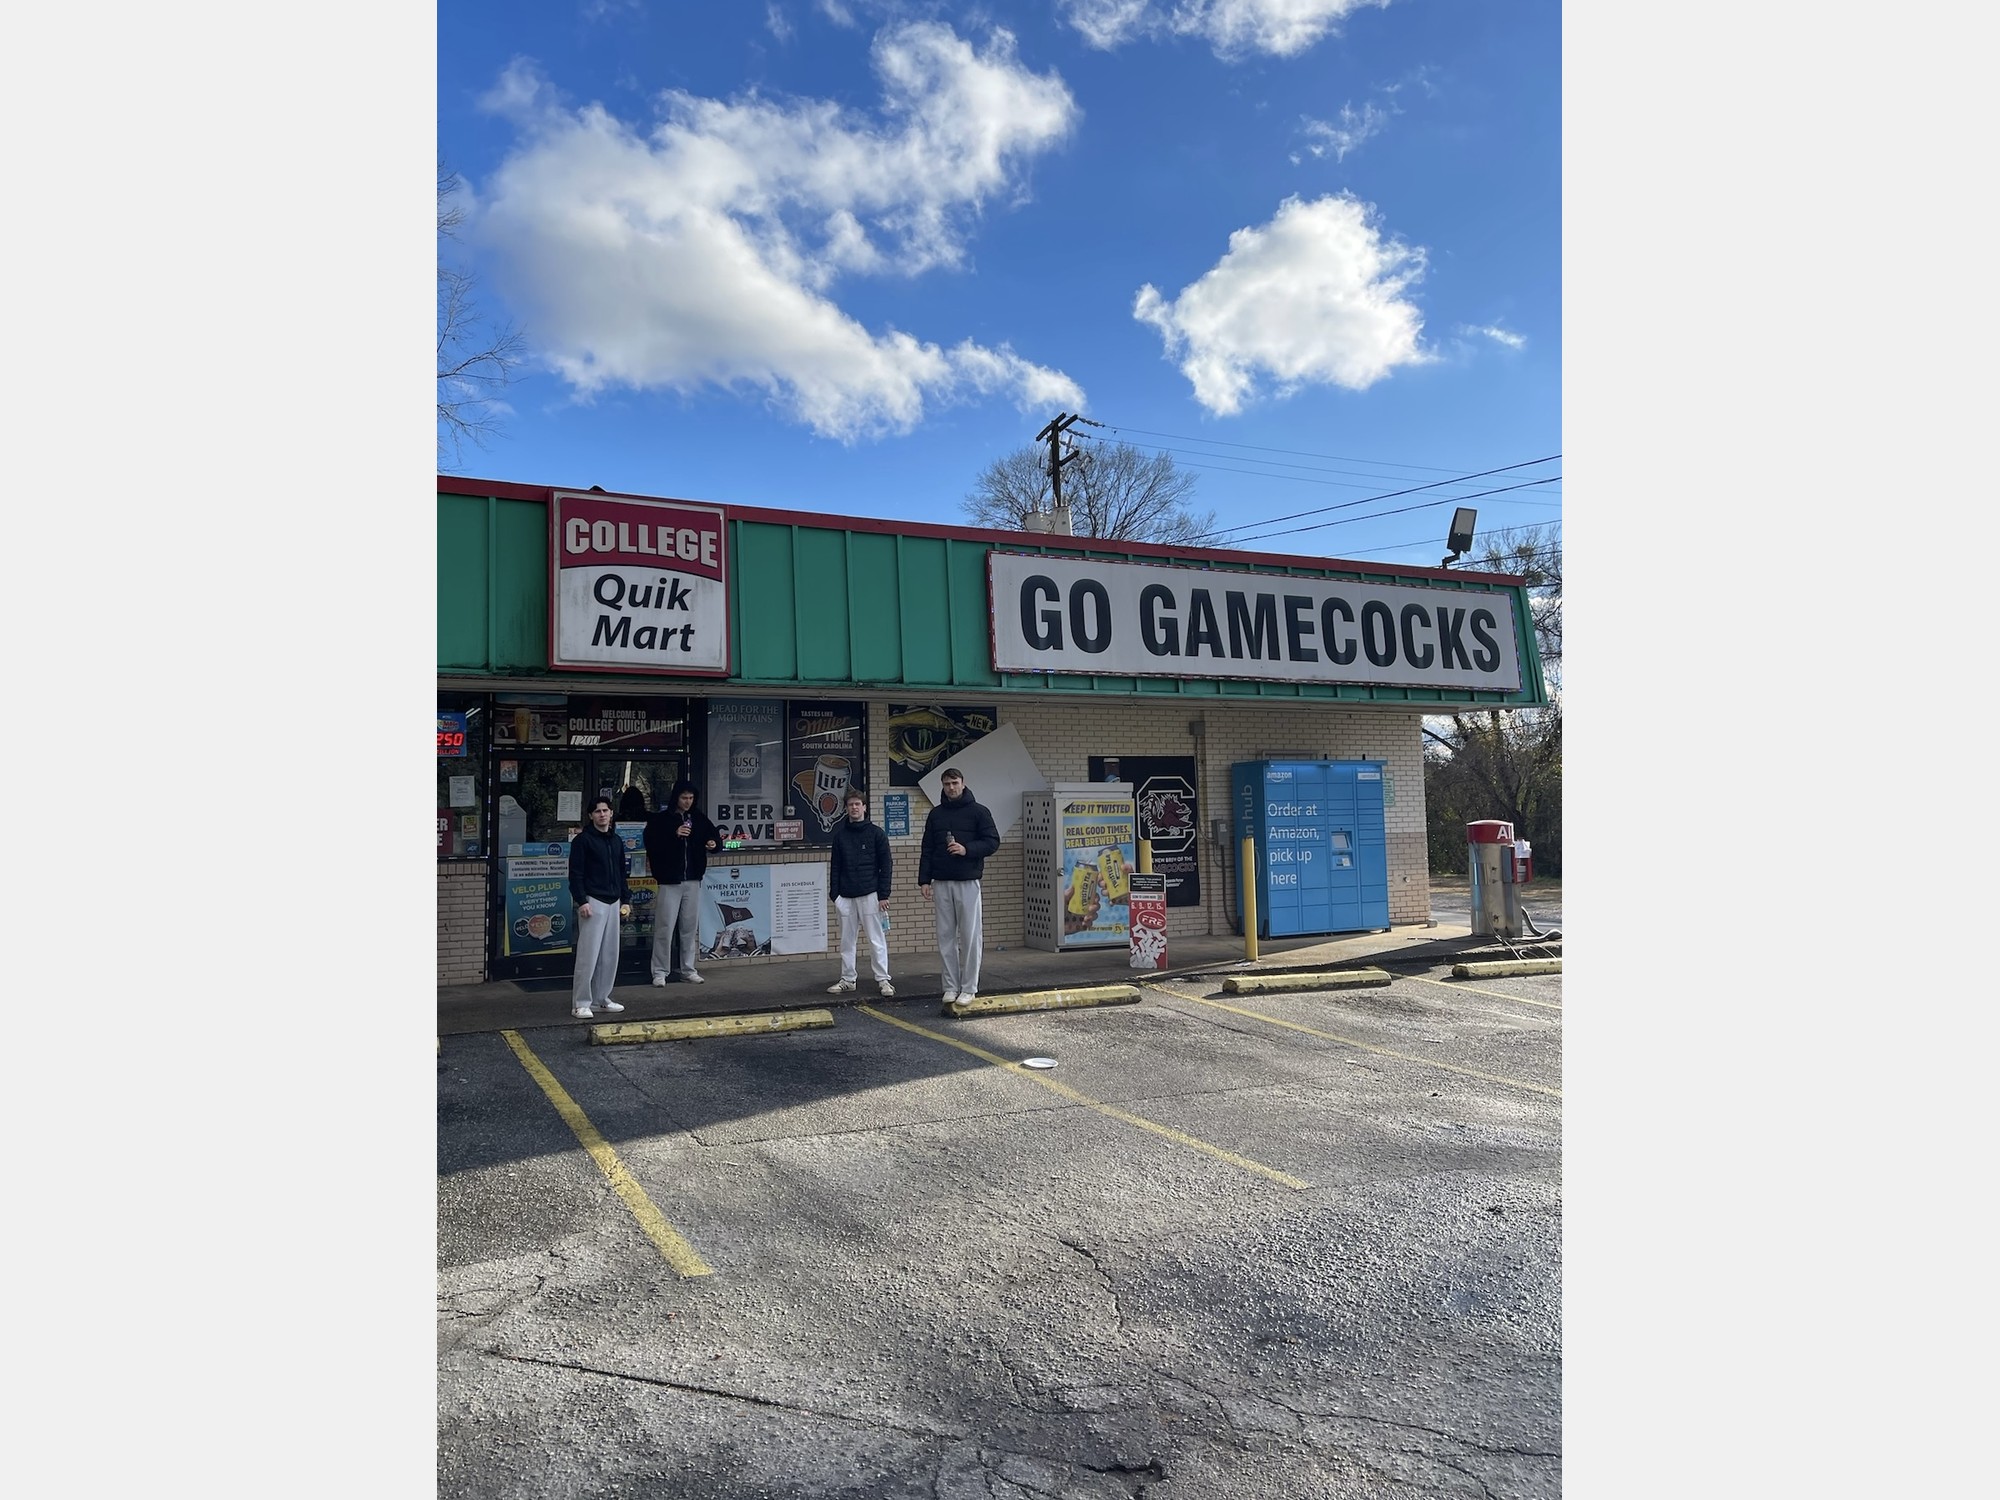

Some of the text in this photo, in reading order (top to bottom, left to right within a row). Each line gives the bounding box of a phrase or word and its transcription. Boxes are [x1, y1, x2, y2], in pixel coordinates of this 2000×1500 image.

[565, 518, 718, 568] COLLEGE
[593, 573, 691, 611] Quik
[1020, 574, 1500, 672] GO GAMECOCKS
[591, 616, 694, 652] Mart
[602, 710, 646, 719] WELCOME TO
[712, 704, 778, 714] HEAD FOR THE
[718, 714, 773, 723] MOUNTAINS
[796, 716, 851, 734] Miller
[971, 716, 989, 730] NEW
[569, 718, 678, 733] COLLEGE QUICK MART
[817, 772, 846, 790] Lite
[718, 804, 774, 820] BEER
[1087, 804, 1095, 814] IT
[1096, 804, 1130, 814] TWISTED
[1268, 803, 1317, 816] Order at
[718, 824, 774, 840] CAVE
[1066, 825, 1130, 836] REAL GOOD TIMES.
[1269, 827, 1320, 840] Amazon,
[1065, 837, 1131, 848] REAL BREWED TEA.
[1270, 848, 1312, 865] pick up
[1271, 872, 1297, 884] here
[512, 882, 561, 894] VELO PLUS
[519, 896, 557, 906] EVERYTHING
